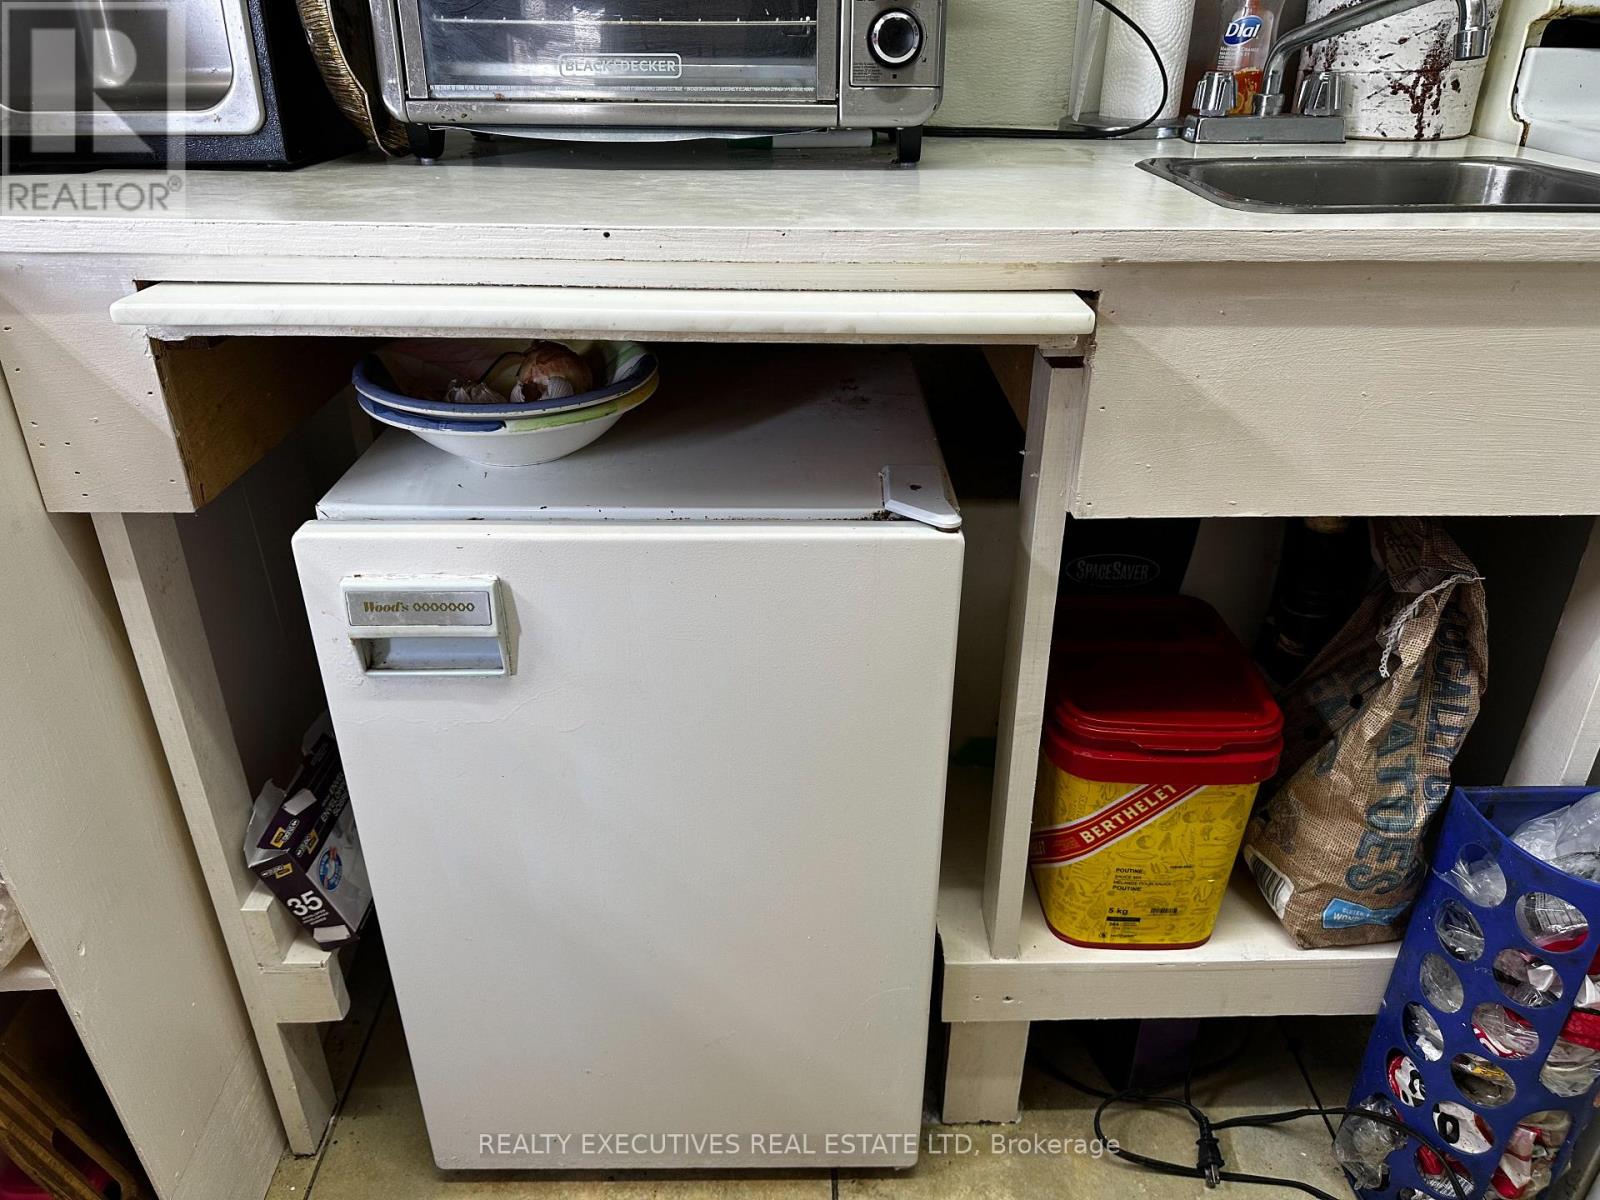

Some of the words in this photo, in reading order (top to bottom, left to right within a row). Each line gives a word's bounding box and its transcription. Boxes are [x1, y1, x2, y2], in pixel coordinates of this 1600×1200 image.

[1225, 22, 1261, 38] Dial
[363, 601, 410, 613] Wood's
[287, 890, 323, 916] 35
[1117, 907, 1129, 916] kg
